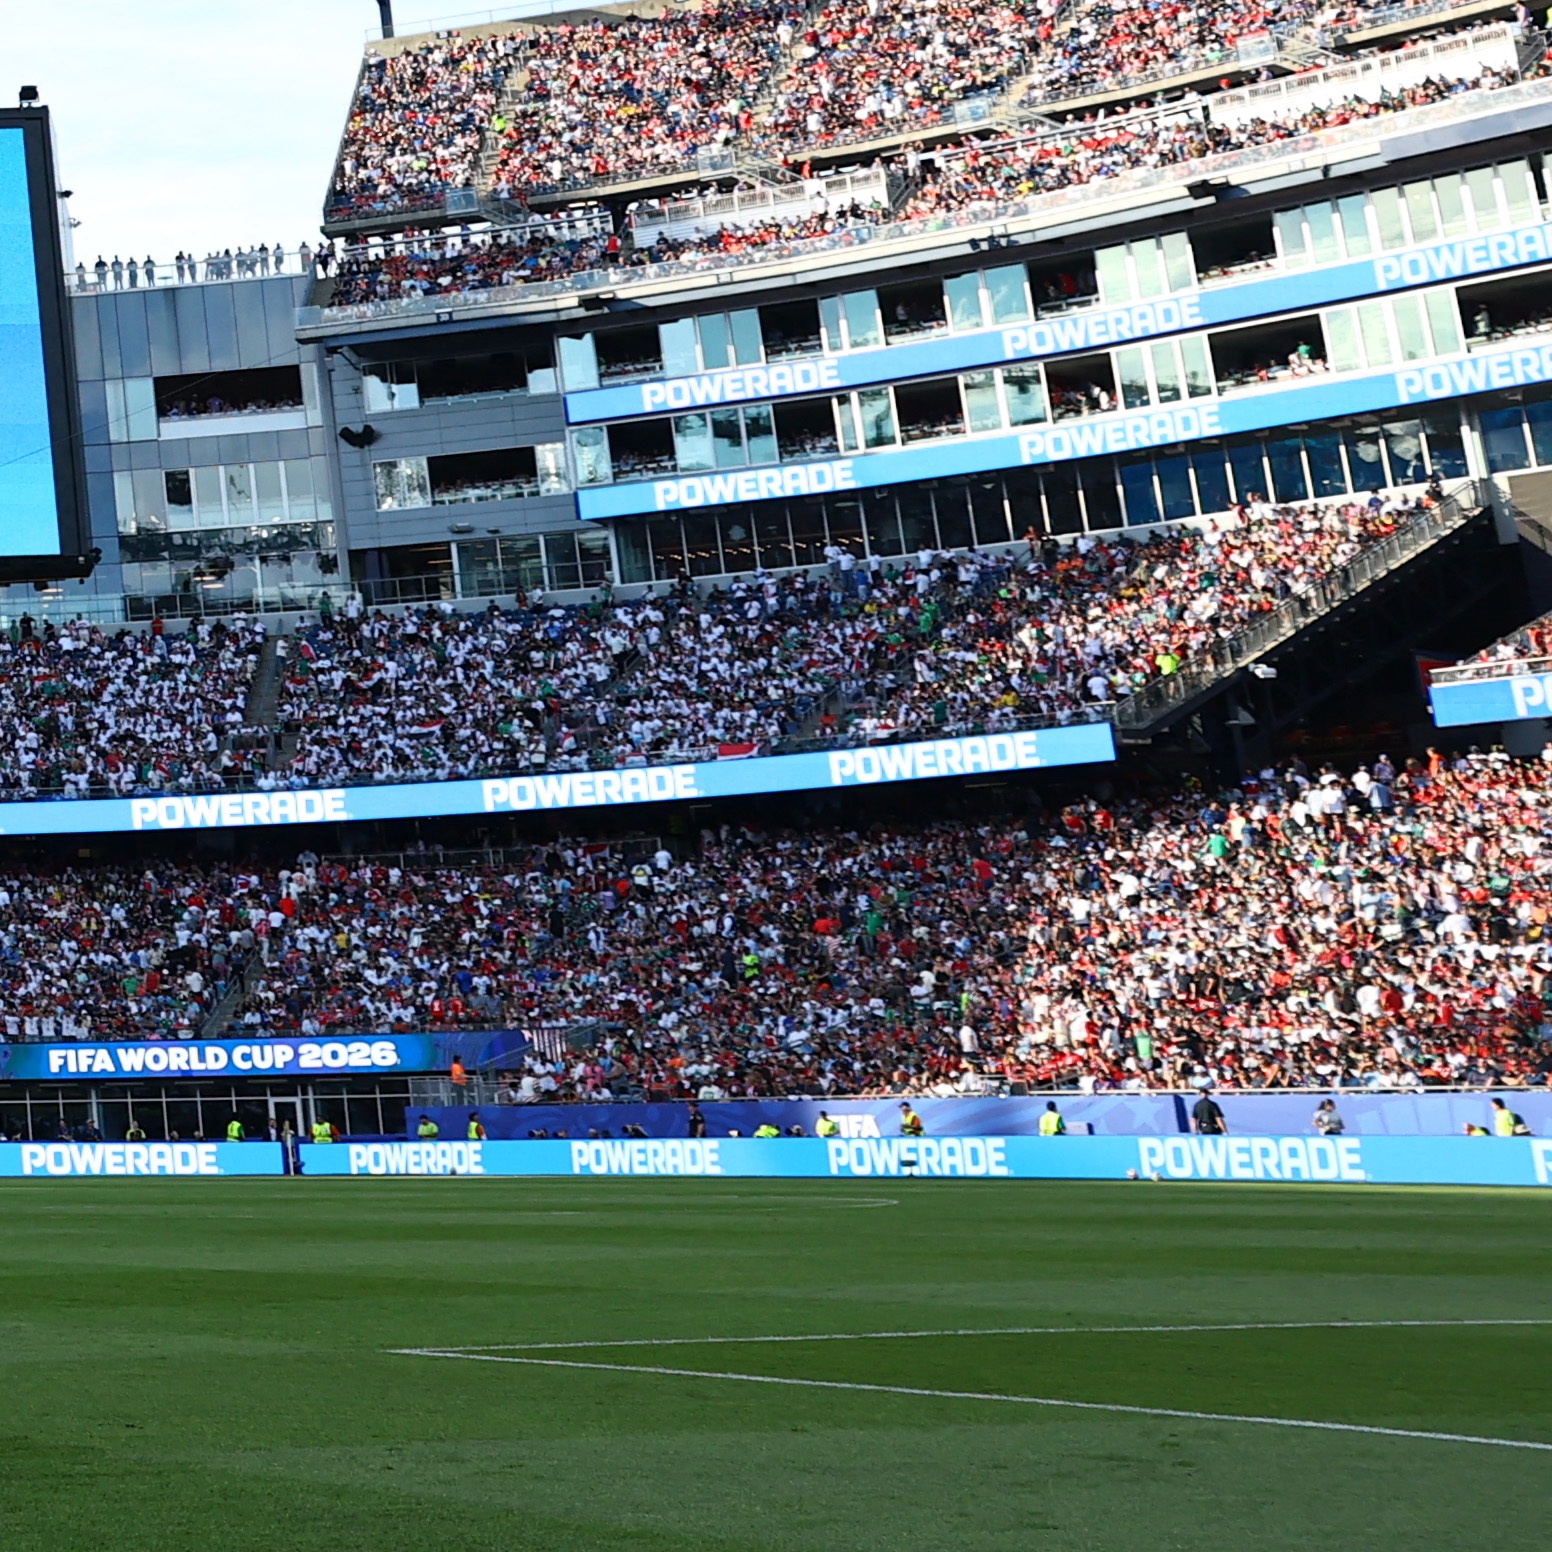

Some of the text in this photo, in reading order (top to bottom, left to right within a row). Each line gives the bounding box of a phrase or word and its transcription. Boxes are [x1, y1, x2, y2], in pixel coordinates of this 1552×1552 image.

[1375, 223, 1552, 290] POWERA
[1001, 295, 1201, 359] POWERADE
[642, 359, 839, 411] POWERADE
[1020, 404, 1223, 464] POWERADE
[654, 461, 856, 510] POWERADE
[830, 732, 1039, 785] POWERADE
[131, 788, 348, 830] POWERADE
[483, 764, 697, 812] POWERADE
[49, 1043, 399, 1073] FIFA WORLD CUP 2026
[22, 1144, 218, 1176] POWERADE
[349, 1144, 482, 1174] POWERADE
[571, 1140, 721, 1175] POWERADE
[827, 1138, 1006, 1176] POWERADE
[1139, 1137, 1364, 1181] POWERADE
